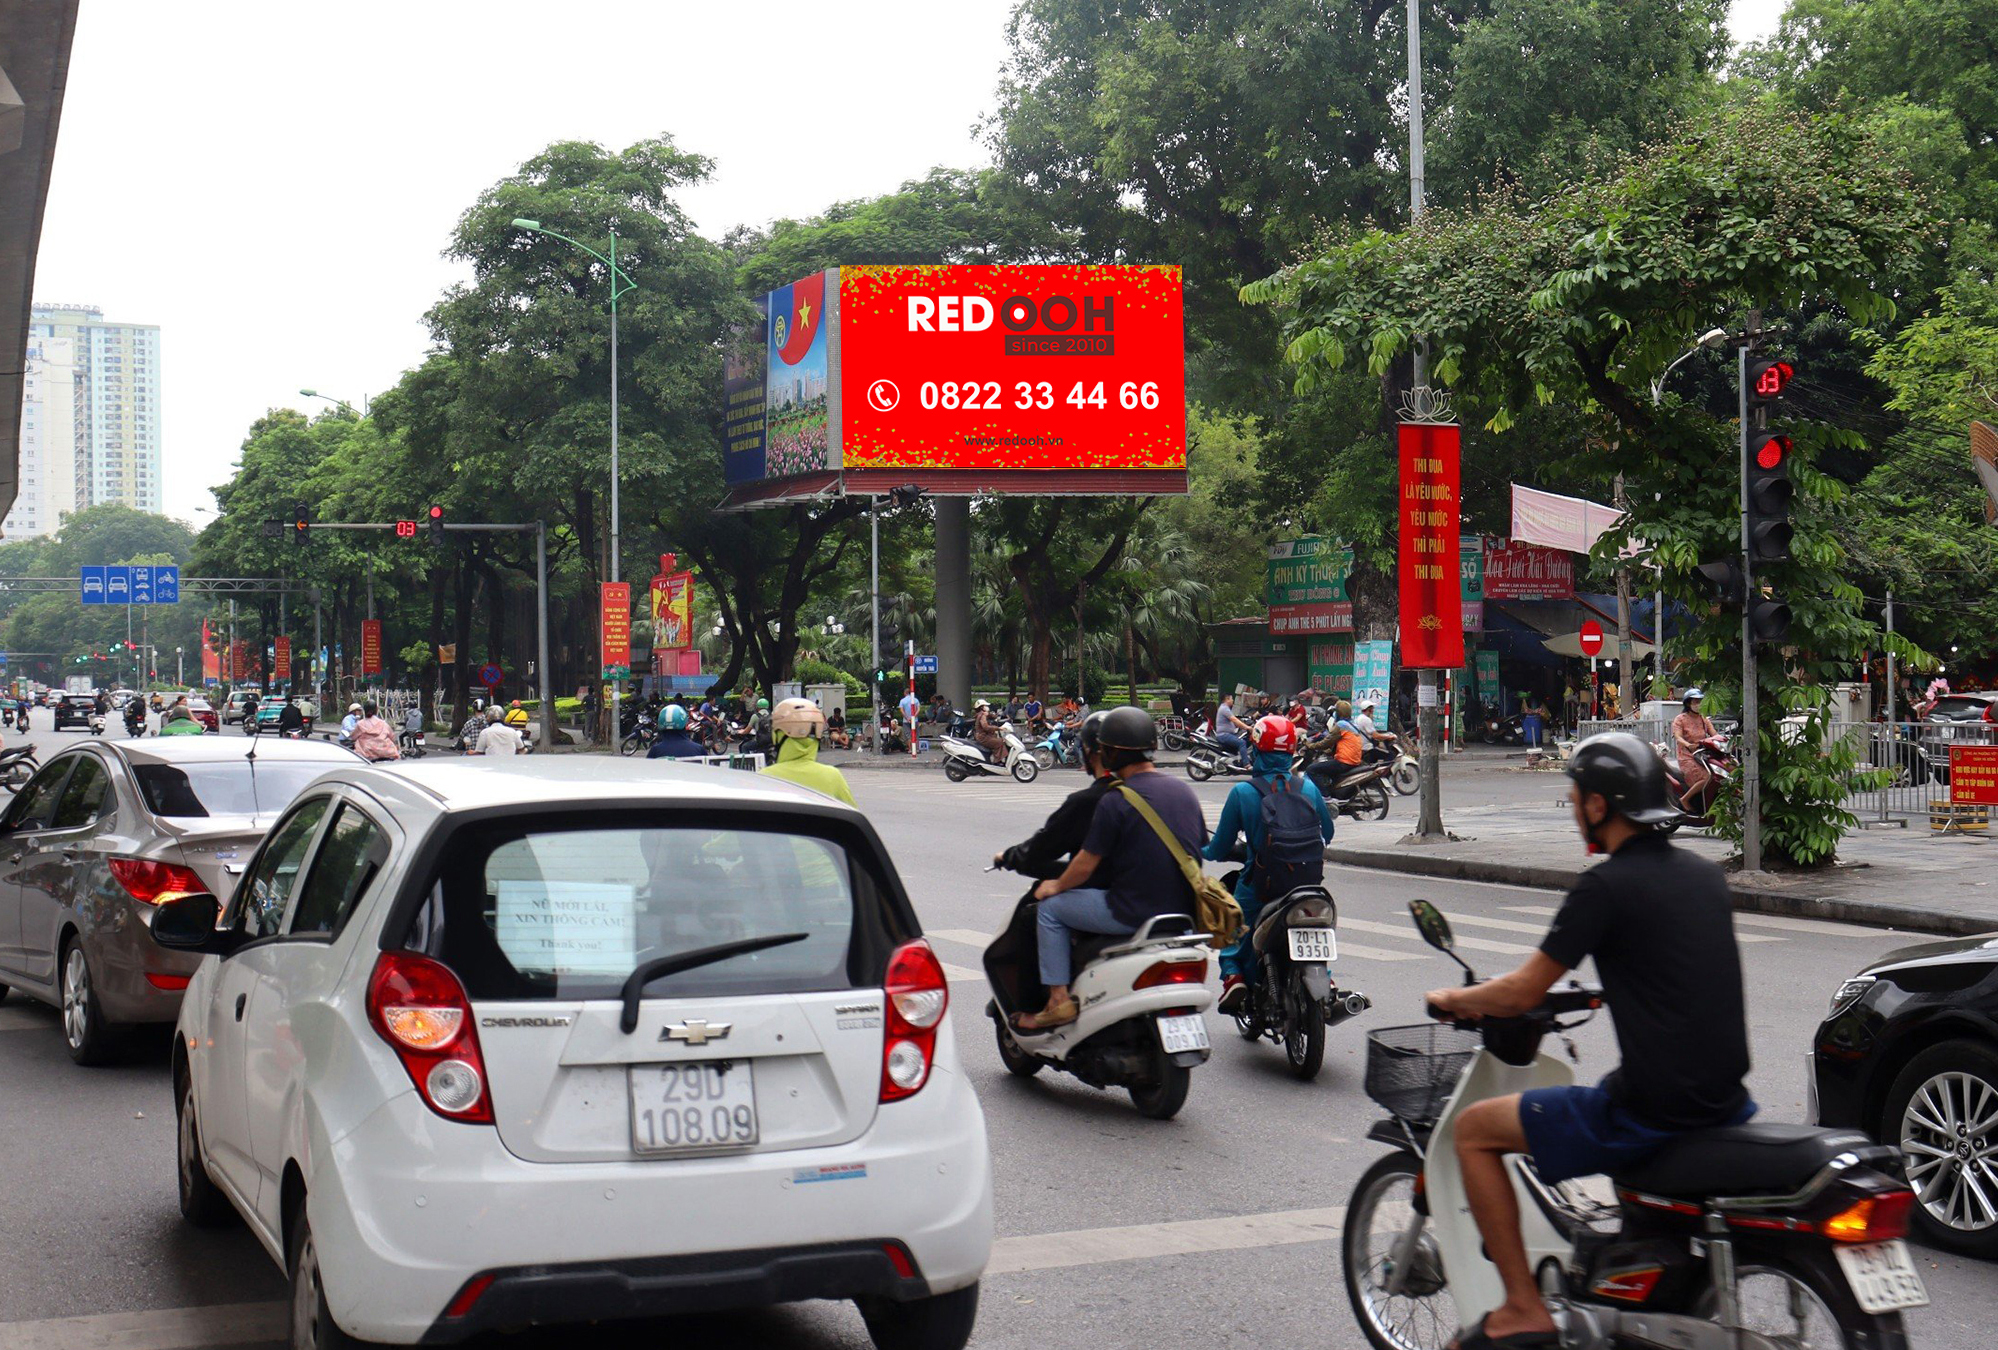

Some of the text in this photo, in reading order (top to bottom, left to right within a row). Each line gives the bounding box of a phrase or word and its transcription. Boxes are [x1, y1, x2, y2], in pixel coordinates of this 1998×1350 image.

[908, 295, 1114, 331] RED OOH
[1012, 337, 1107, 352] since 2010
[920, 381, 1159, 409] 0822 33 44 66
[964, 435, 1064, 446] www.redooh.vn
[1413, 458, 1427, 473] THI
[1405, 481, 1414, 499] LÀ
[1415, 482, 1430, 499] YÊU
[1410, 508, 1448, 527] YÊU NƯỚC
[397, 521, 414, 536] 03
[1413, 533, 1445, 553] THÌ PHẢI
[1414, 565, 1428, 579] THI
[1461, 556, 1477, 579] SỐ
[1310, 616, 1315, 629] 5
[1312, 644, 1319, 665] IN
[1325, 675, 1353, 692] PLAST
[555, 899, 580, 912] MỚI
[516, 913, 538, 923] XIN
[543, 914, 588, 926] THÔNG
[540, 939, 602, 951] Thank you!
[1297, 945, 1330, 958] 9350
[482, 1016, 571, 1028] CHEVROLET
[661, 1065, 725, 1102] 29D
[643, 1104, 752, 1146] 108.09
